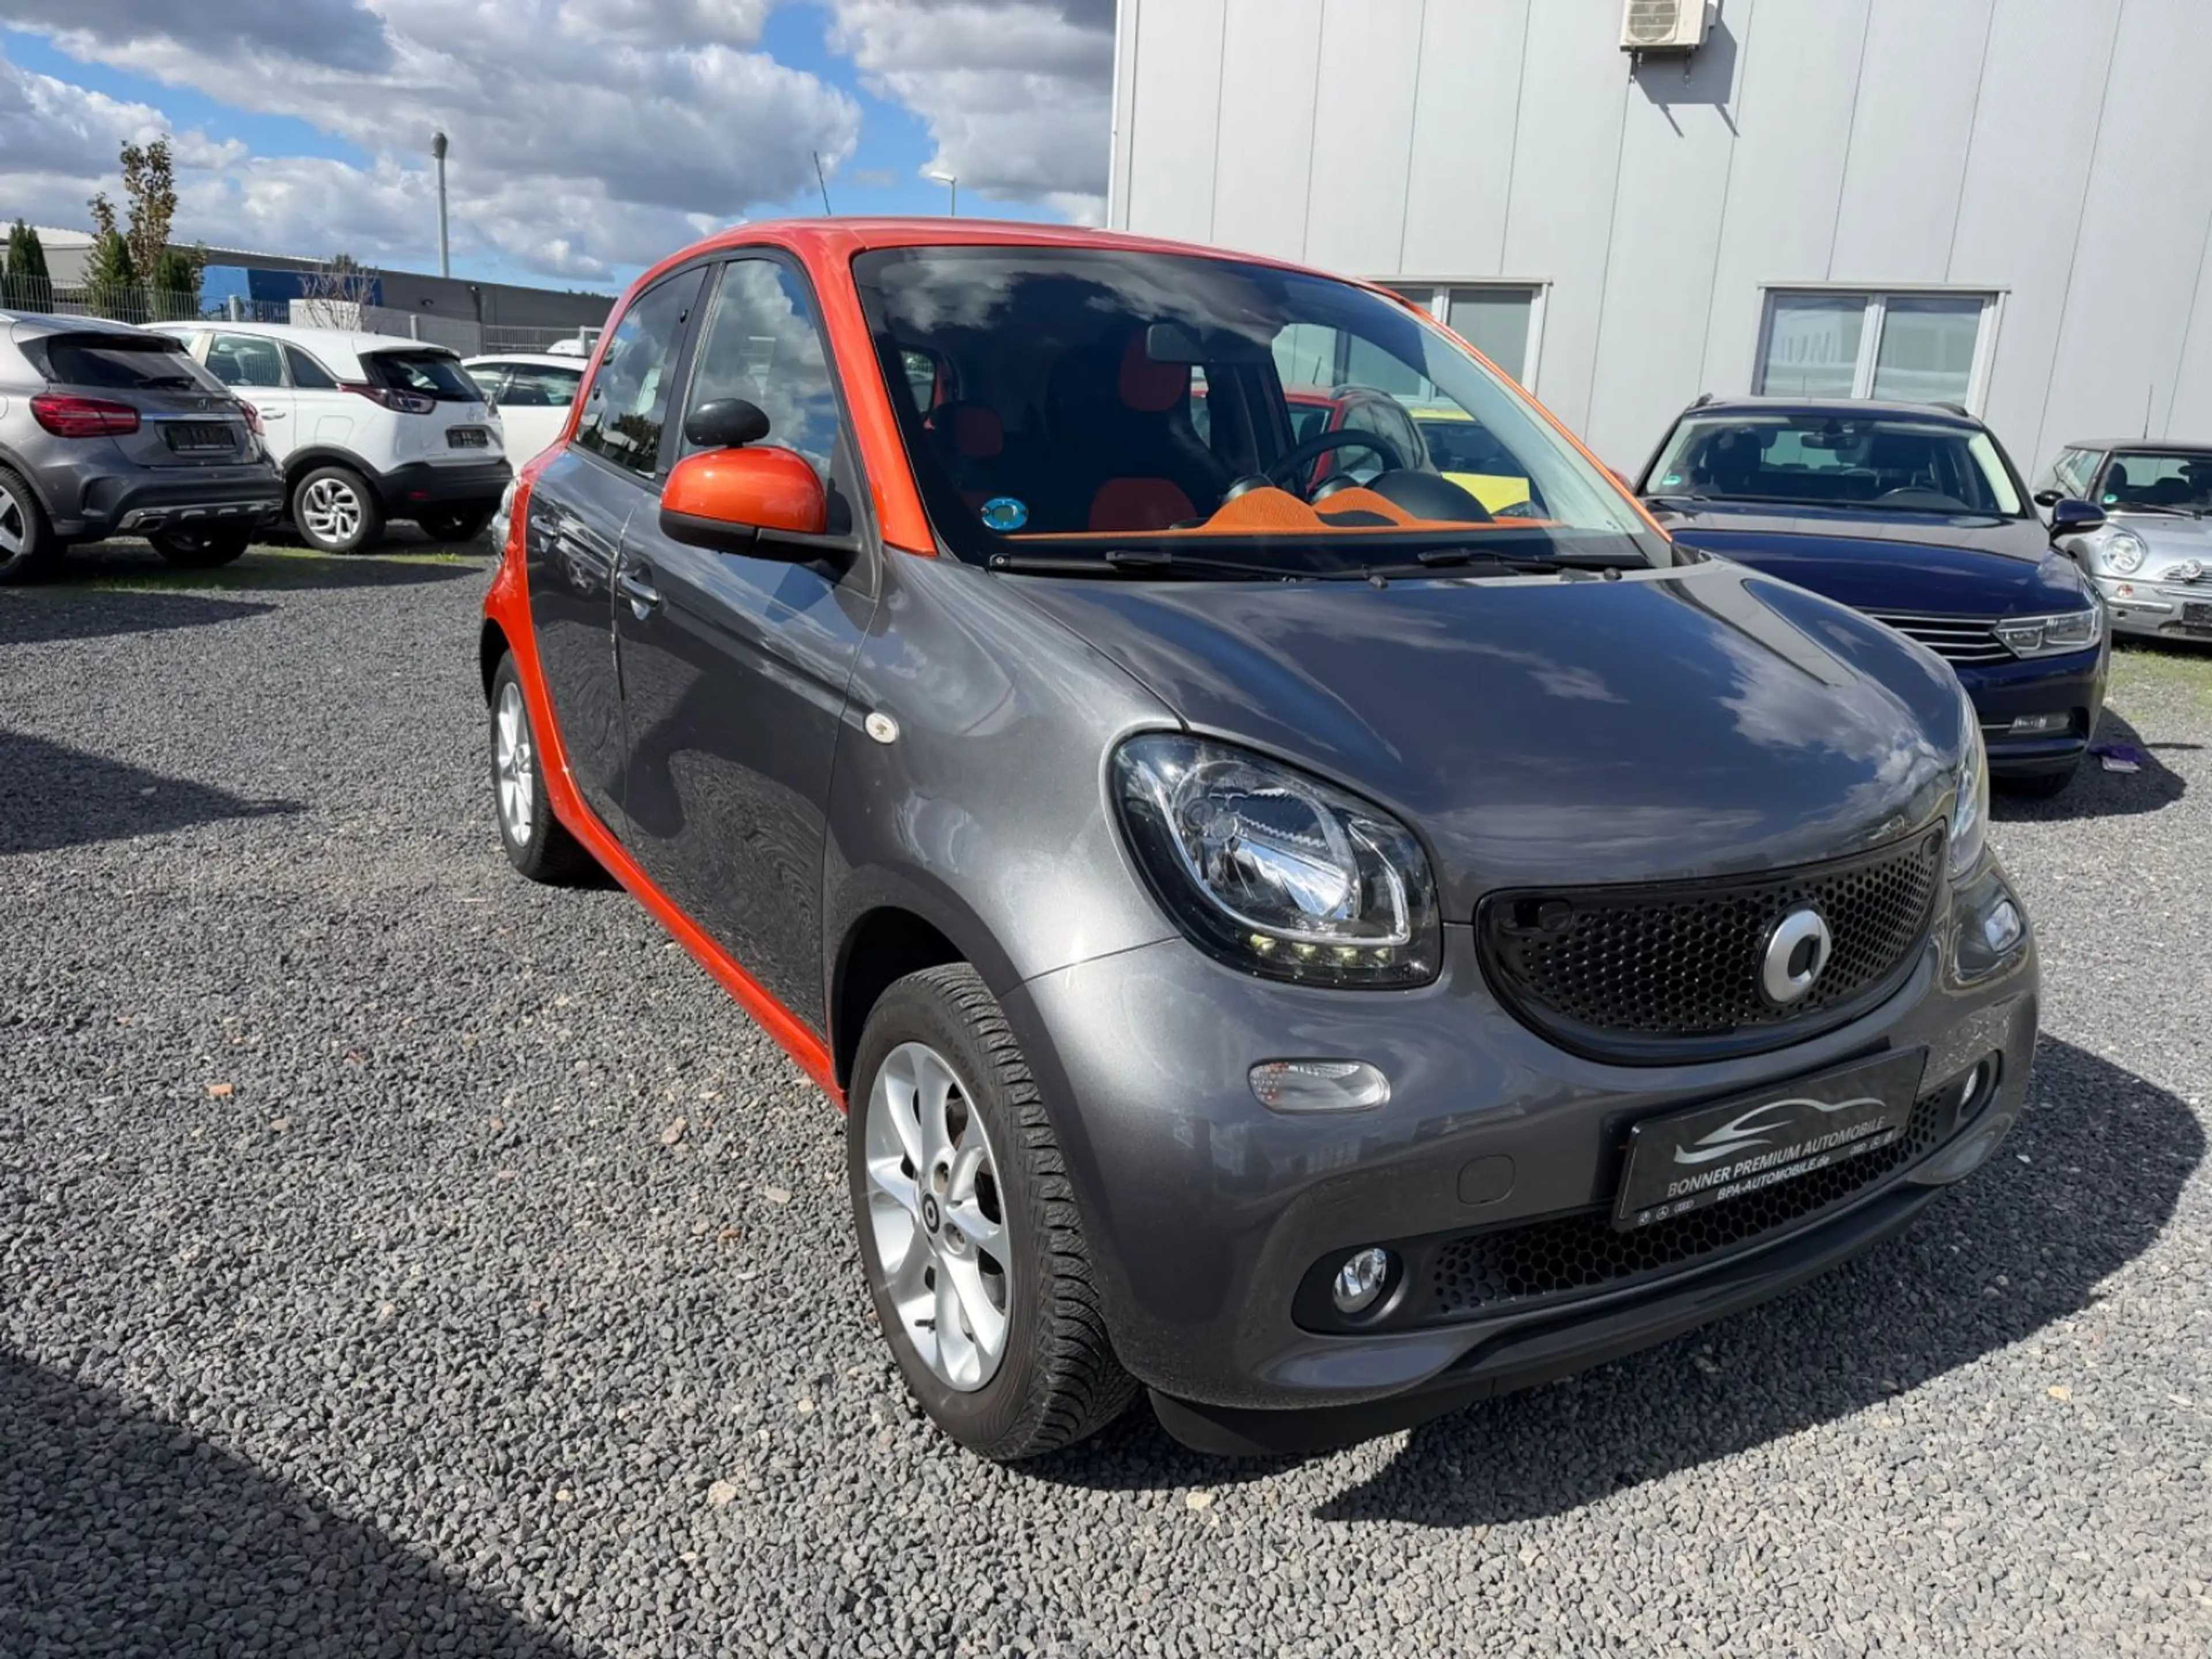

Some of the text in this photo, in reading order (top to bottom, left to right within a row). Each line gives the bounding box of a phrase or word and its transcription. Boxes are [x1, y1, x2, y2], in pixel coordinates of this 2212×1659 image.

[1667, 1116, 1886, 1198] BONNER PREMIUM AUTOMOBILE
[1717, 1156, 1831, 1200] BPA-AUTOMOBILE.de
